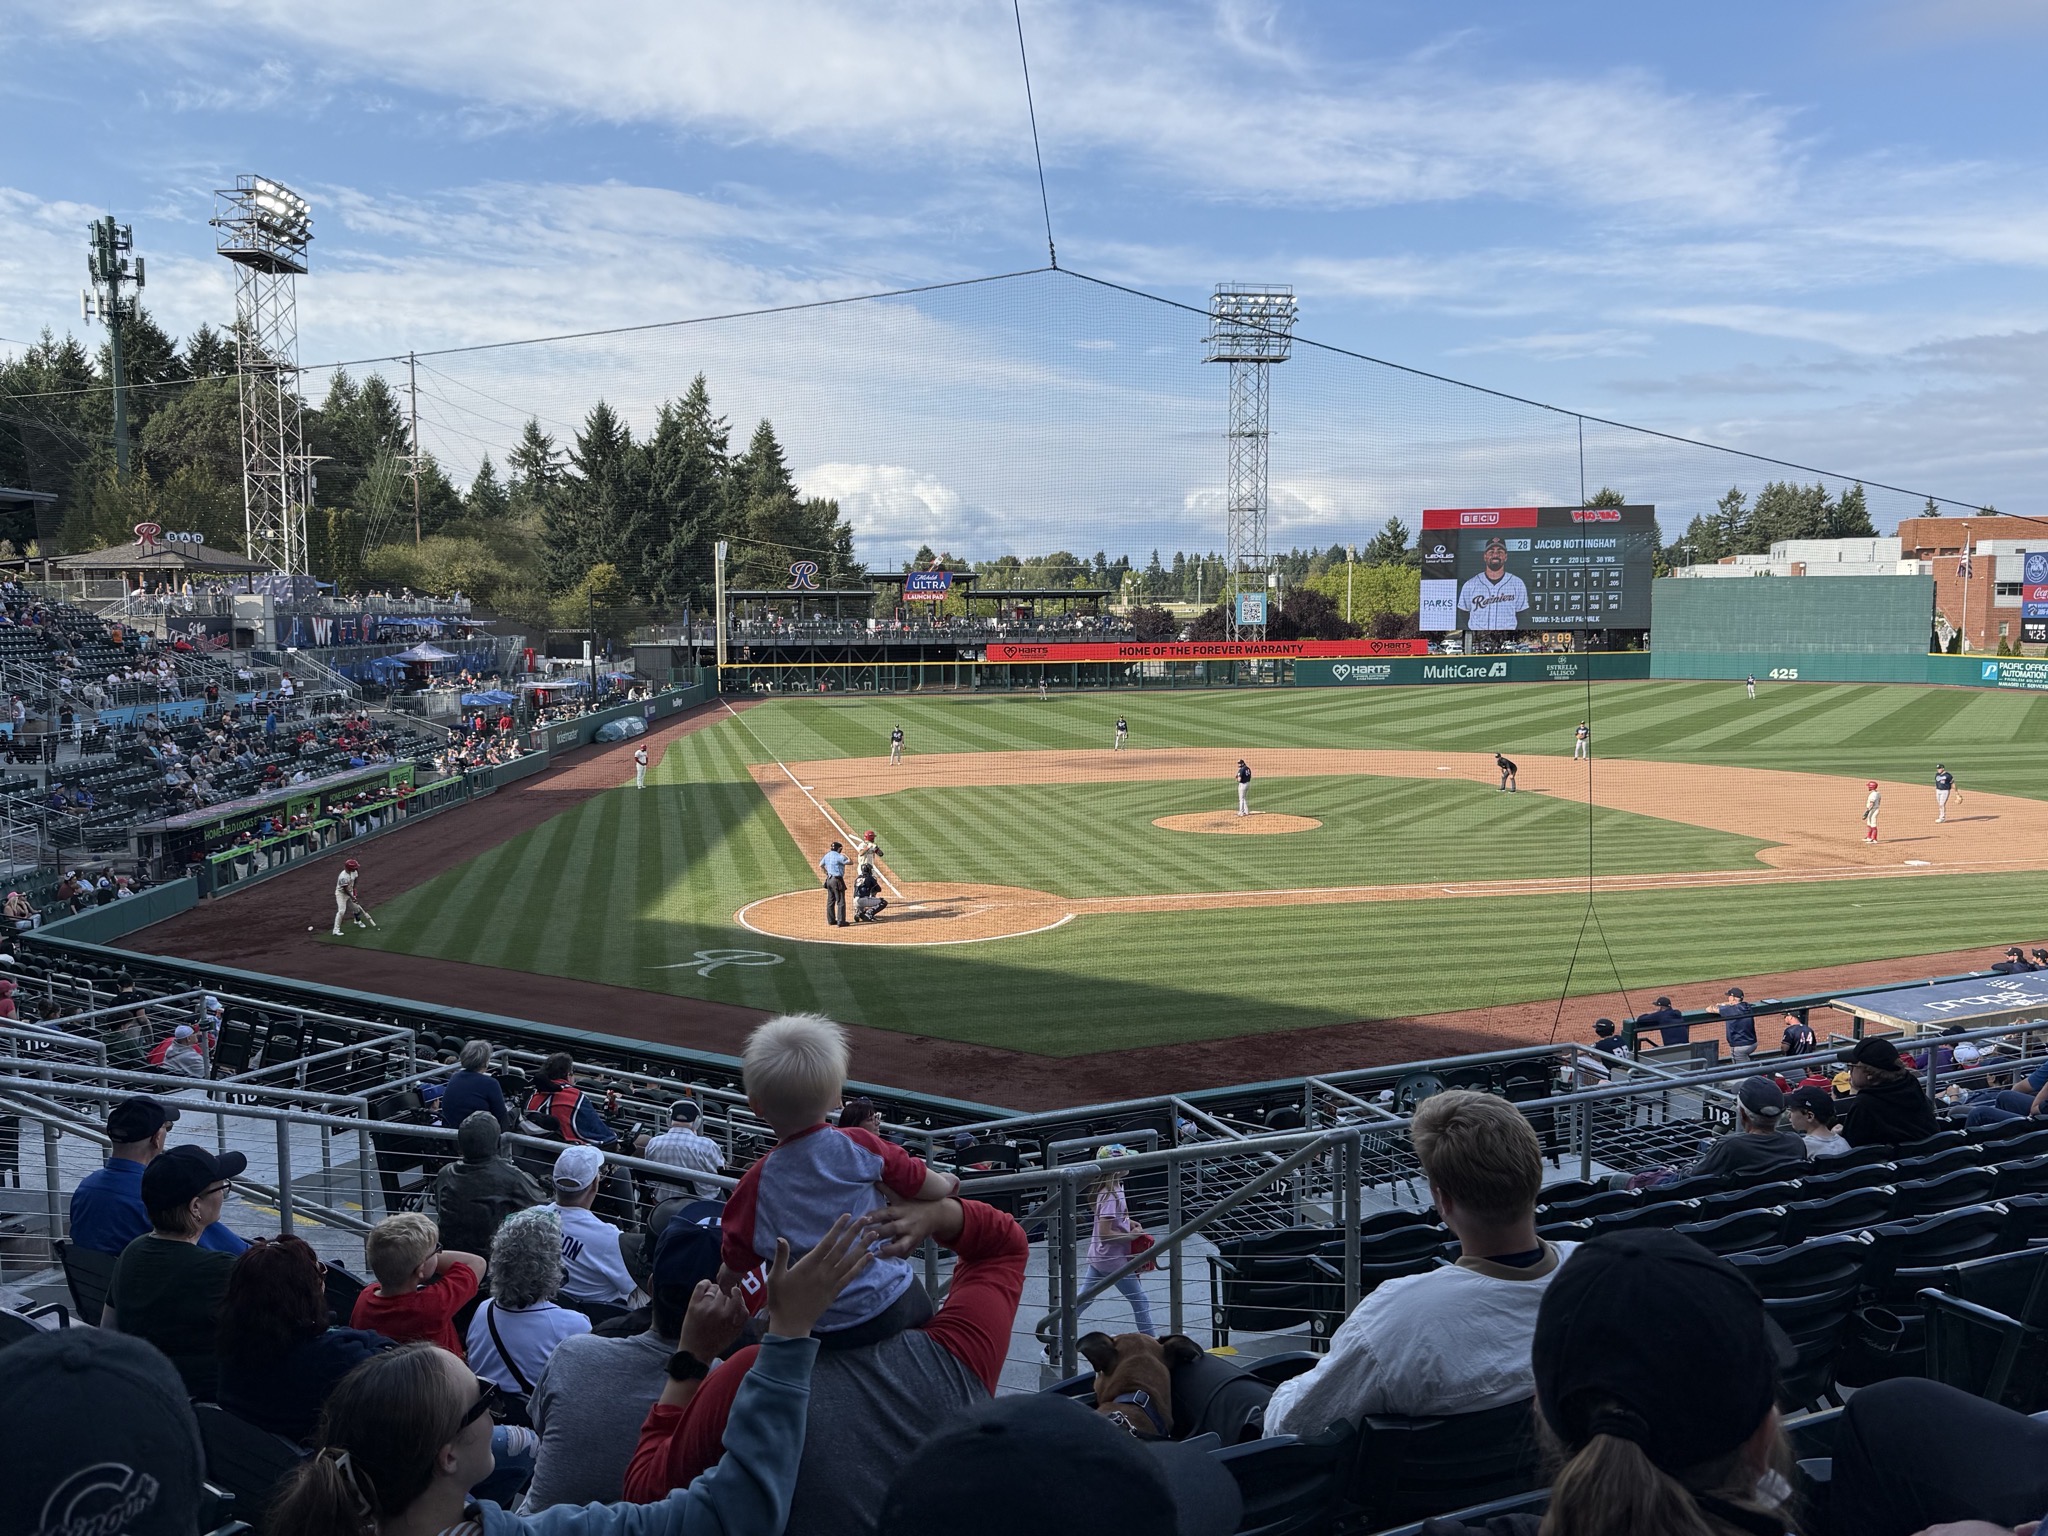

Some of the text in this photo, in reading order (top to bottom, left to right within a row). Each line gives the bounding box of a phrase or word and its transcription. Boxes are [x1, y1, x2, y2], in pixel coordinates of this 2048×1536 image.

[1463, 515, 1496, 523] BECU
[169, 533, 202, 543] BAR
[1534, 538, 1616, 549] JACOB NOTTINGHAM
[1517, 541, 1528, 549] 28
[912, 581, 946, 589] ULTRA
[1542, 633, 1572, 643] 0:09
[2029, 630, 2046, 640] 4:25
[1119, 644, 1304, 656] HOME OF THE FOREVER WARRANTY
[1423, 664, 1487, 679] MultiCare
[1999, 662, 2024, 670] PACIFIC
[1769, 668, 1798, 679] 425
[2001, 670, 2047, 679] AUTOMATION
[204, 828, 222, 841] HOME
[237, 817, 254, 830] LOOKS
[421, 1022, 426, 1030] 5
[1800, 1031, 1813, 1045] 44
[643, 1063, 675, 1077] 5 6
[1708, 1105, 1730, 1126] 118
[925, 1116, 991, 1136] 6 7
[560, 1233, 584, 1261] ON
